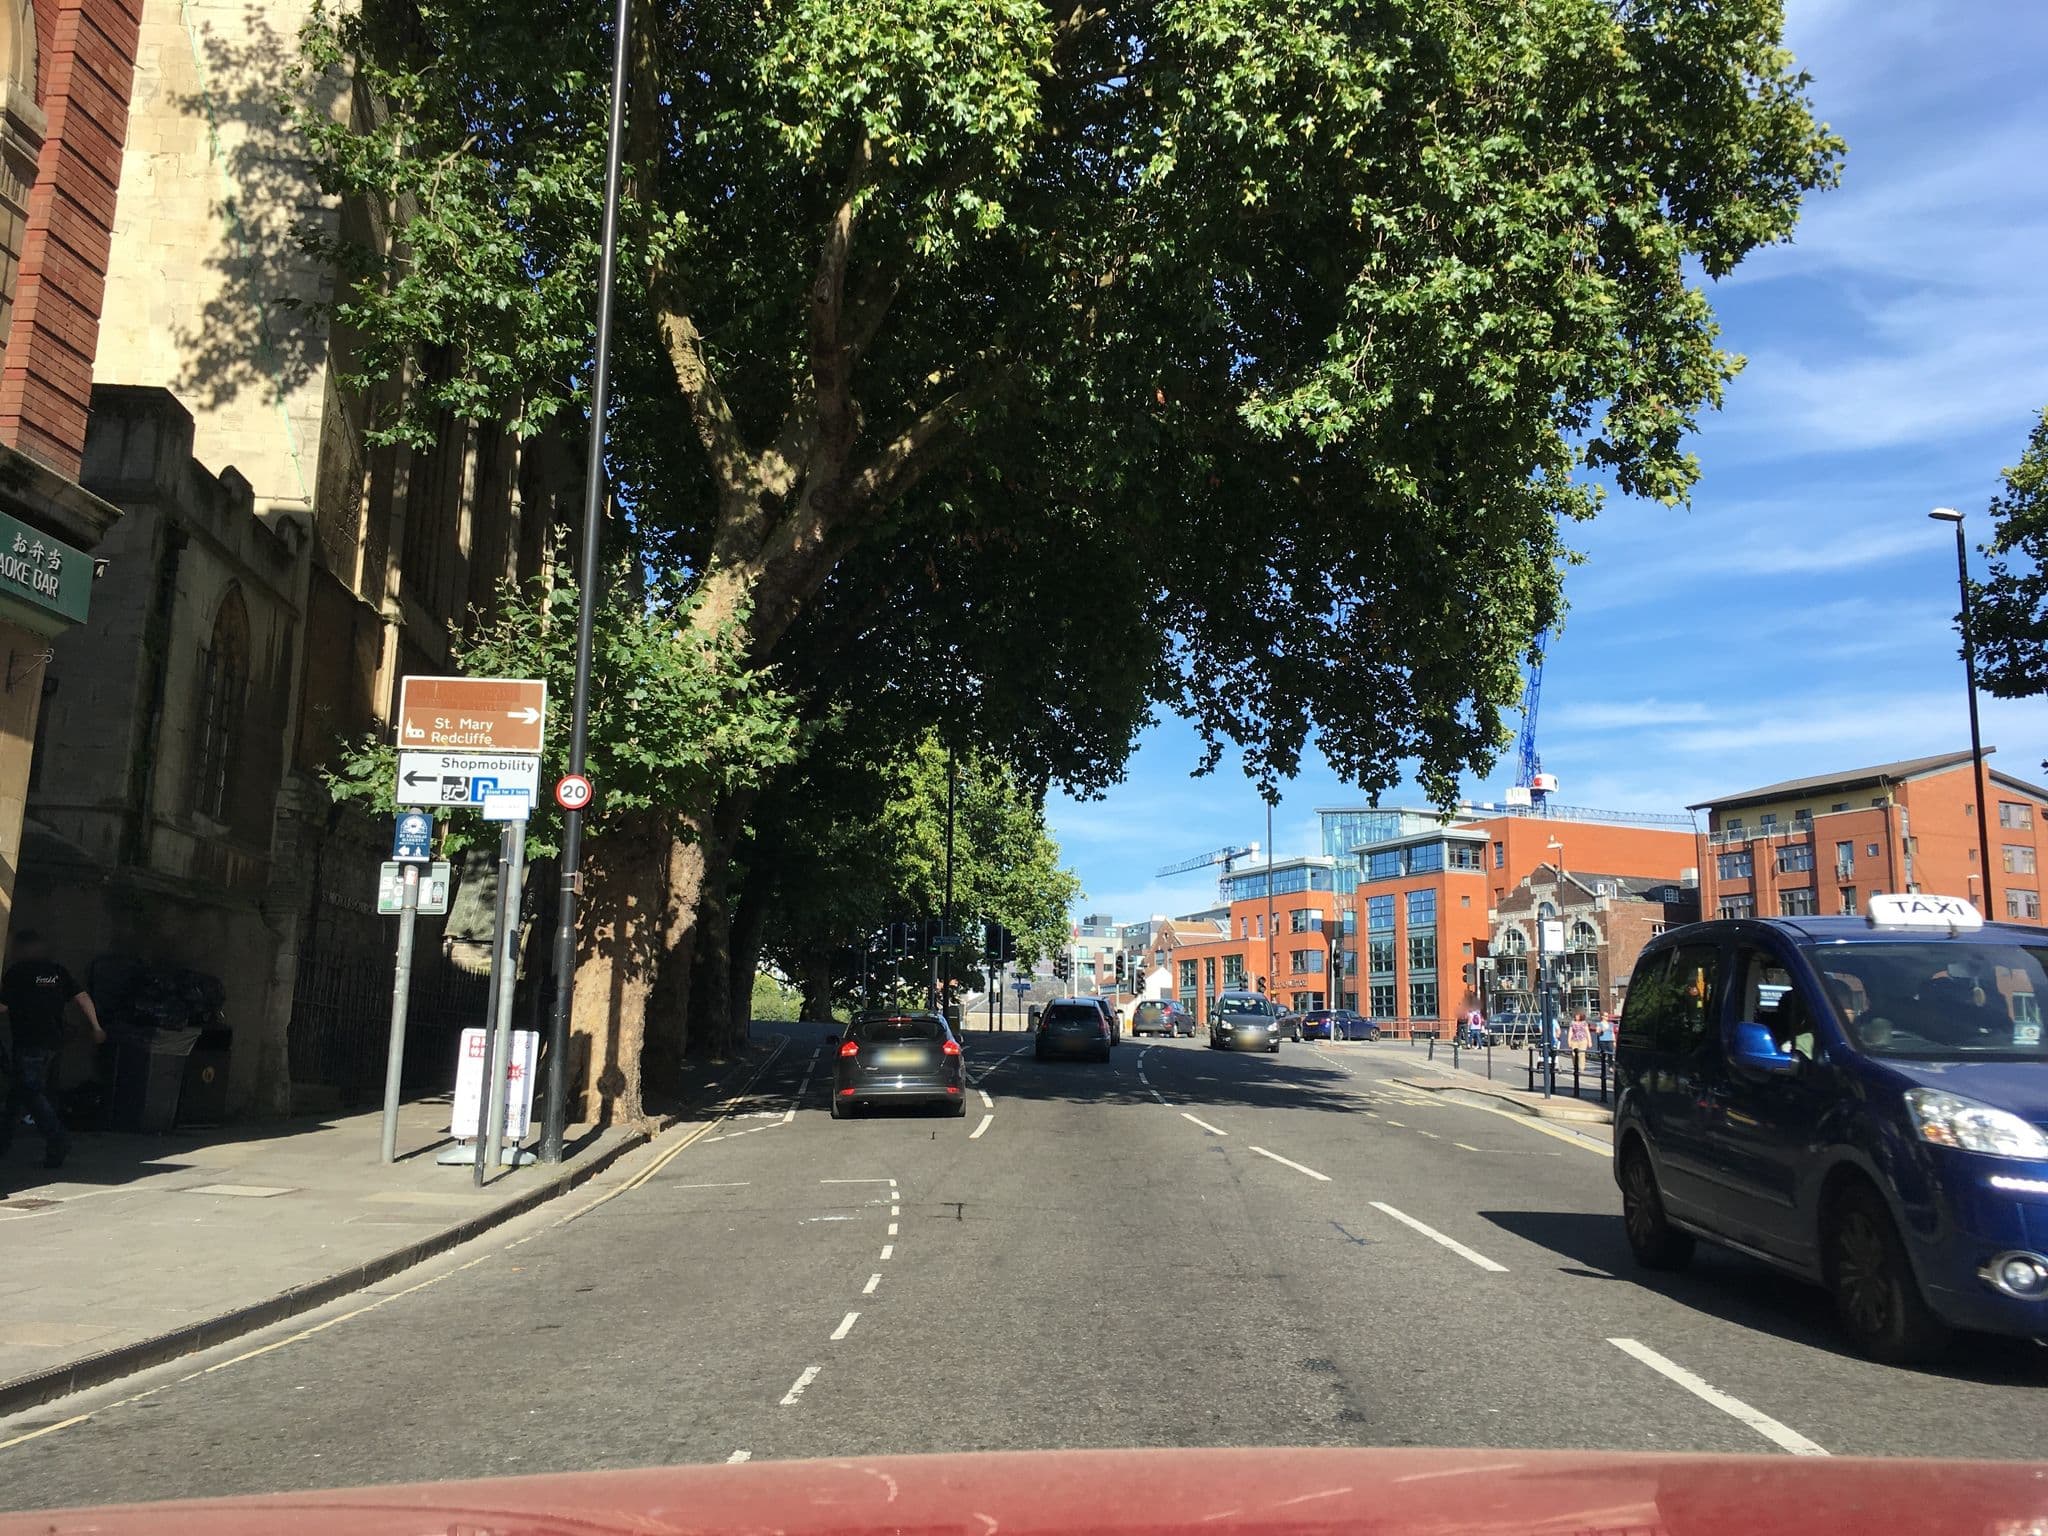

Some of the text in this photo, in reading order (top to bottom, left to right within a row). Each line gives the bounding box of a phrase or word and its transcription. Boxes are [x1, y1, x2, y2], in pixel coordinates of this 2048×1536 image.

[12, 532, 62, 569] お弁当
[33, 569, 58, 597] BAR
[434, 717, 493, 732] St. Mary
[431, 732, 493, 745] Redcliffe
[441, 757, 534, 773] Shopmobility
[562, 785, 586, 799] 20
[1889, 901, 1964, 915] TAXI
